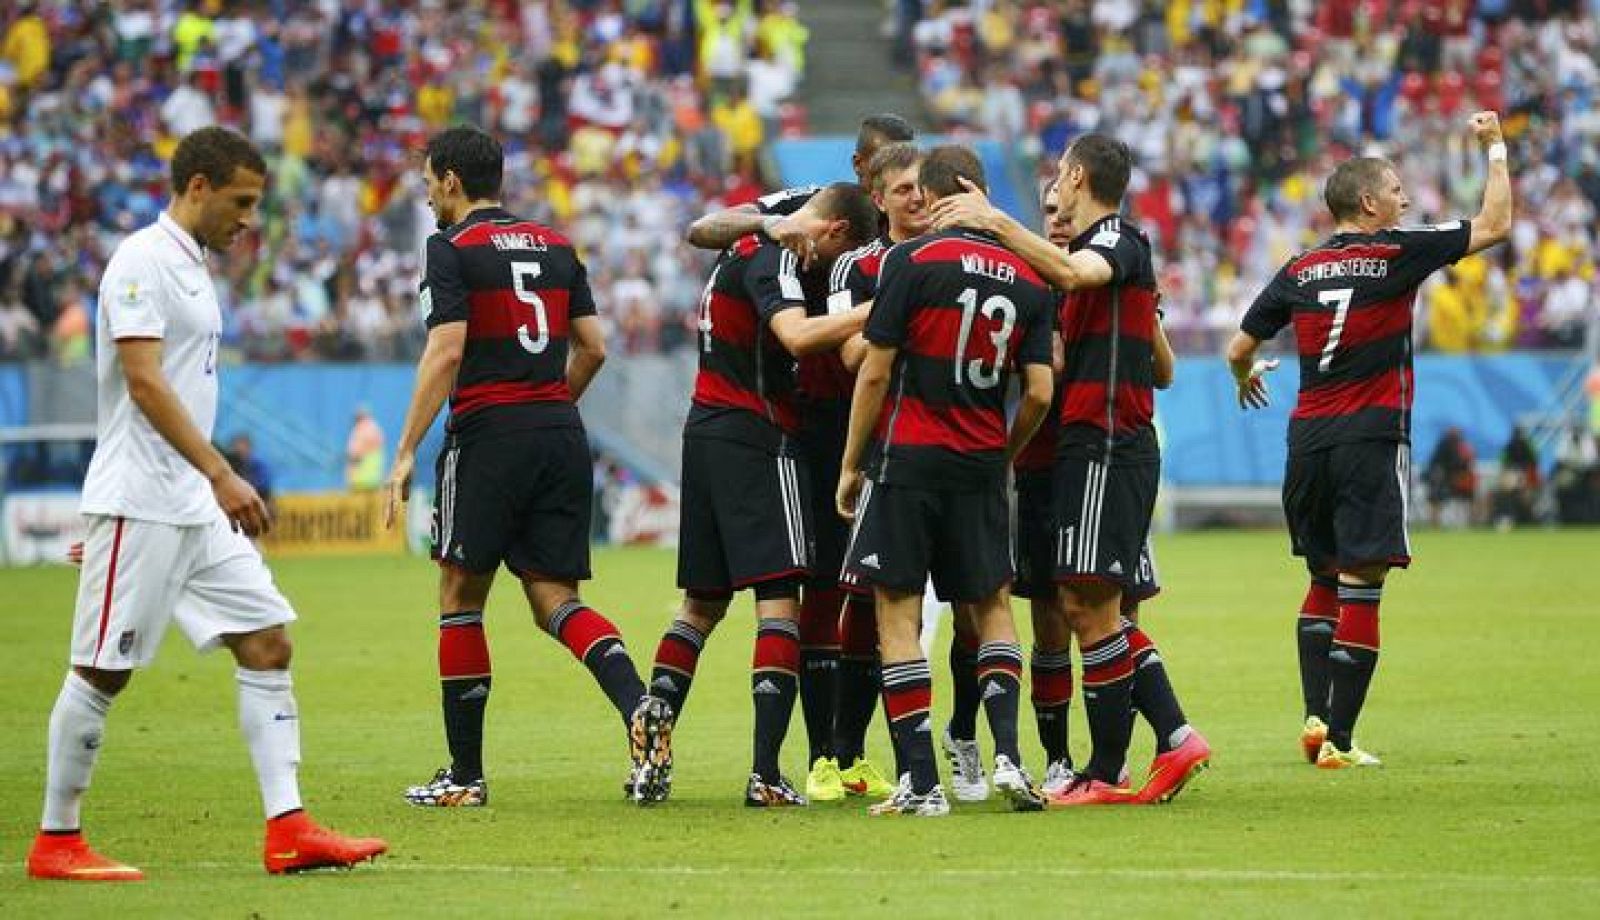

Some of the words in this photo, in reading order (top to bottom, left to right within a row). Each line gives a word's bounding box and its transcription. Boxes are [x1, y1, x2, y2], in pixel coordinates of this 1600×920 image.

[510, 261, 549, 354] 5
[955, 287, 1017, 390] 13
[1317, 288, 1354, 372] 7
